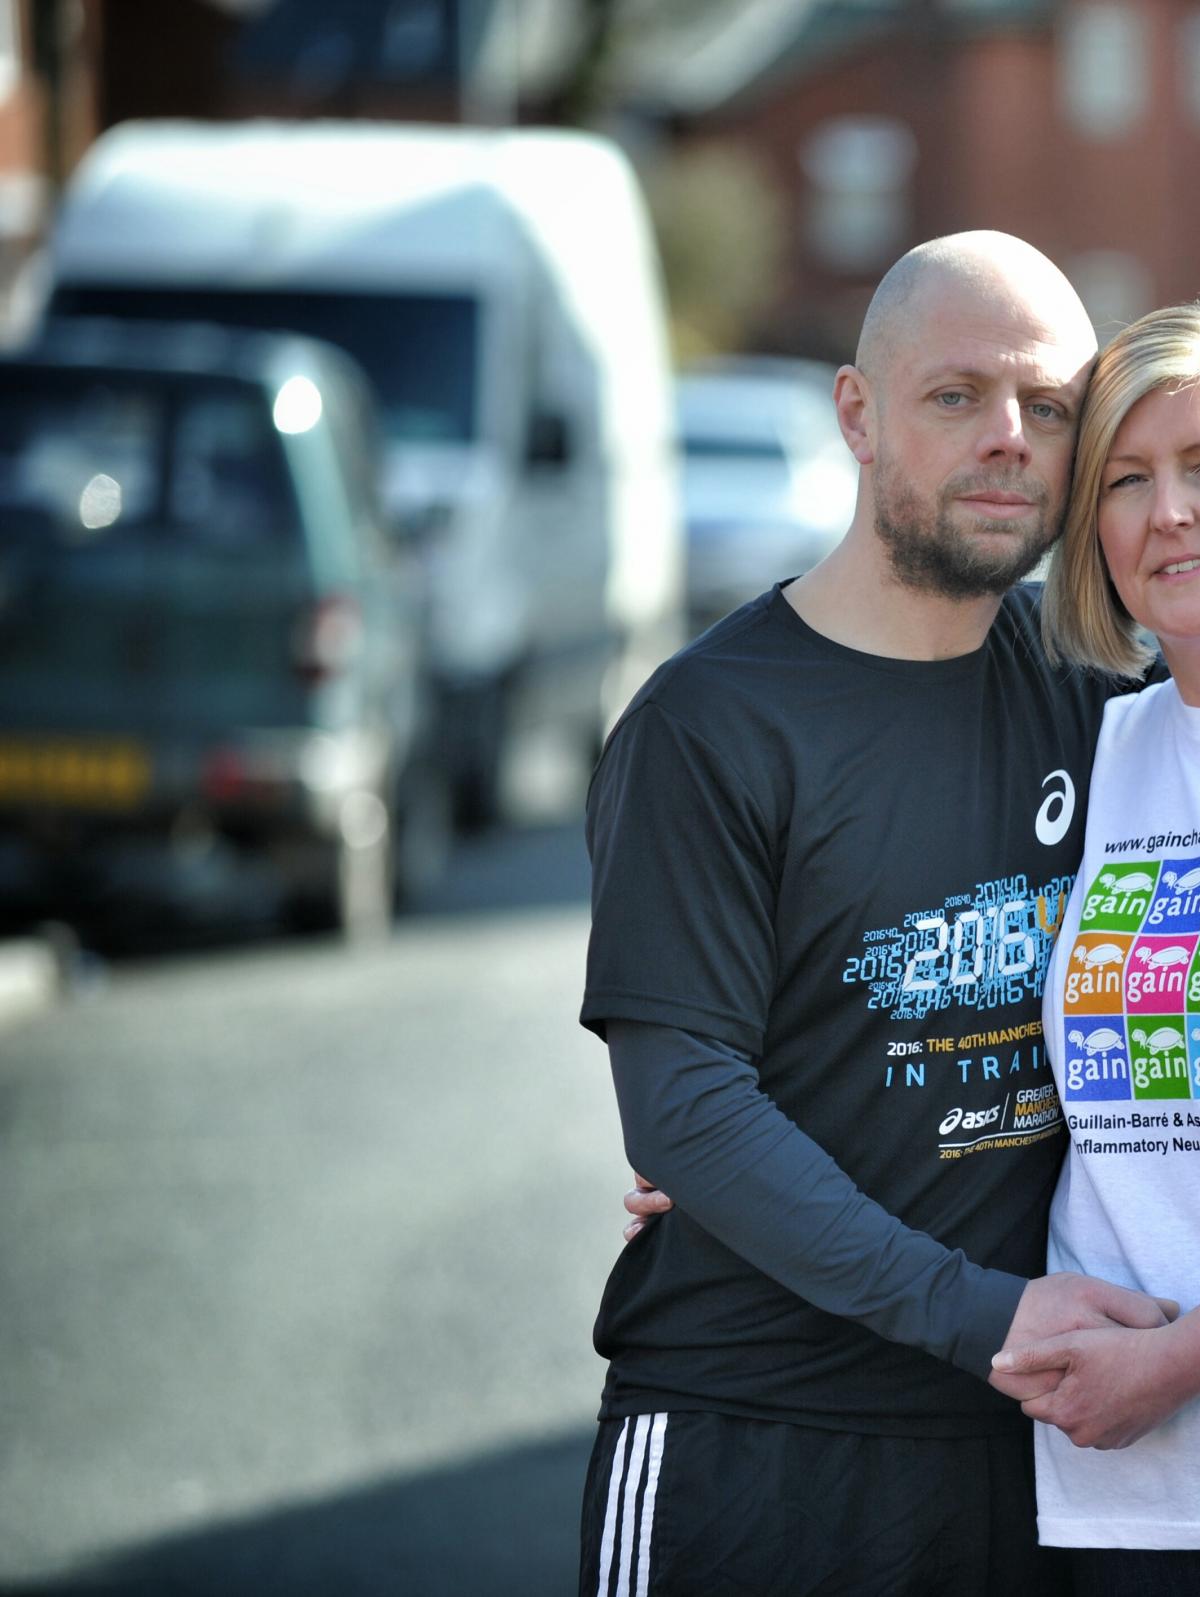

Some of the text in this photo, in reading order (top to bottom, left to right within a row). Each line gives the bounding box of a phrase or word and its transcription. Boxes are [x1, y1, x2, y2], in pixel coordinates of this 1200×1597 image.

[1082, 889, 1147, 921] gain
[1065, 966, 1121, 1003] gain
[1127, 966, 1183, 1002] gain
[886, 1041, 923, 1056] 2016:
[926, 1038, 955, 1052] THE
[957, 1032, 987, 1050] 40TH
[885, 1045, 1047, 1087] IN TRAI
[1066, 1052, 1127, 1089] gain
[1134, 1051, 1187, 1088] gain
[1016, 1084, 1054, 1103] GREATER
[1068, 1112, 1169, 1130] Guillain-Barré
[1173, 1112, 1184, 1127] &
[1075, 1139, 1168, 1155] nflammatory
